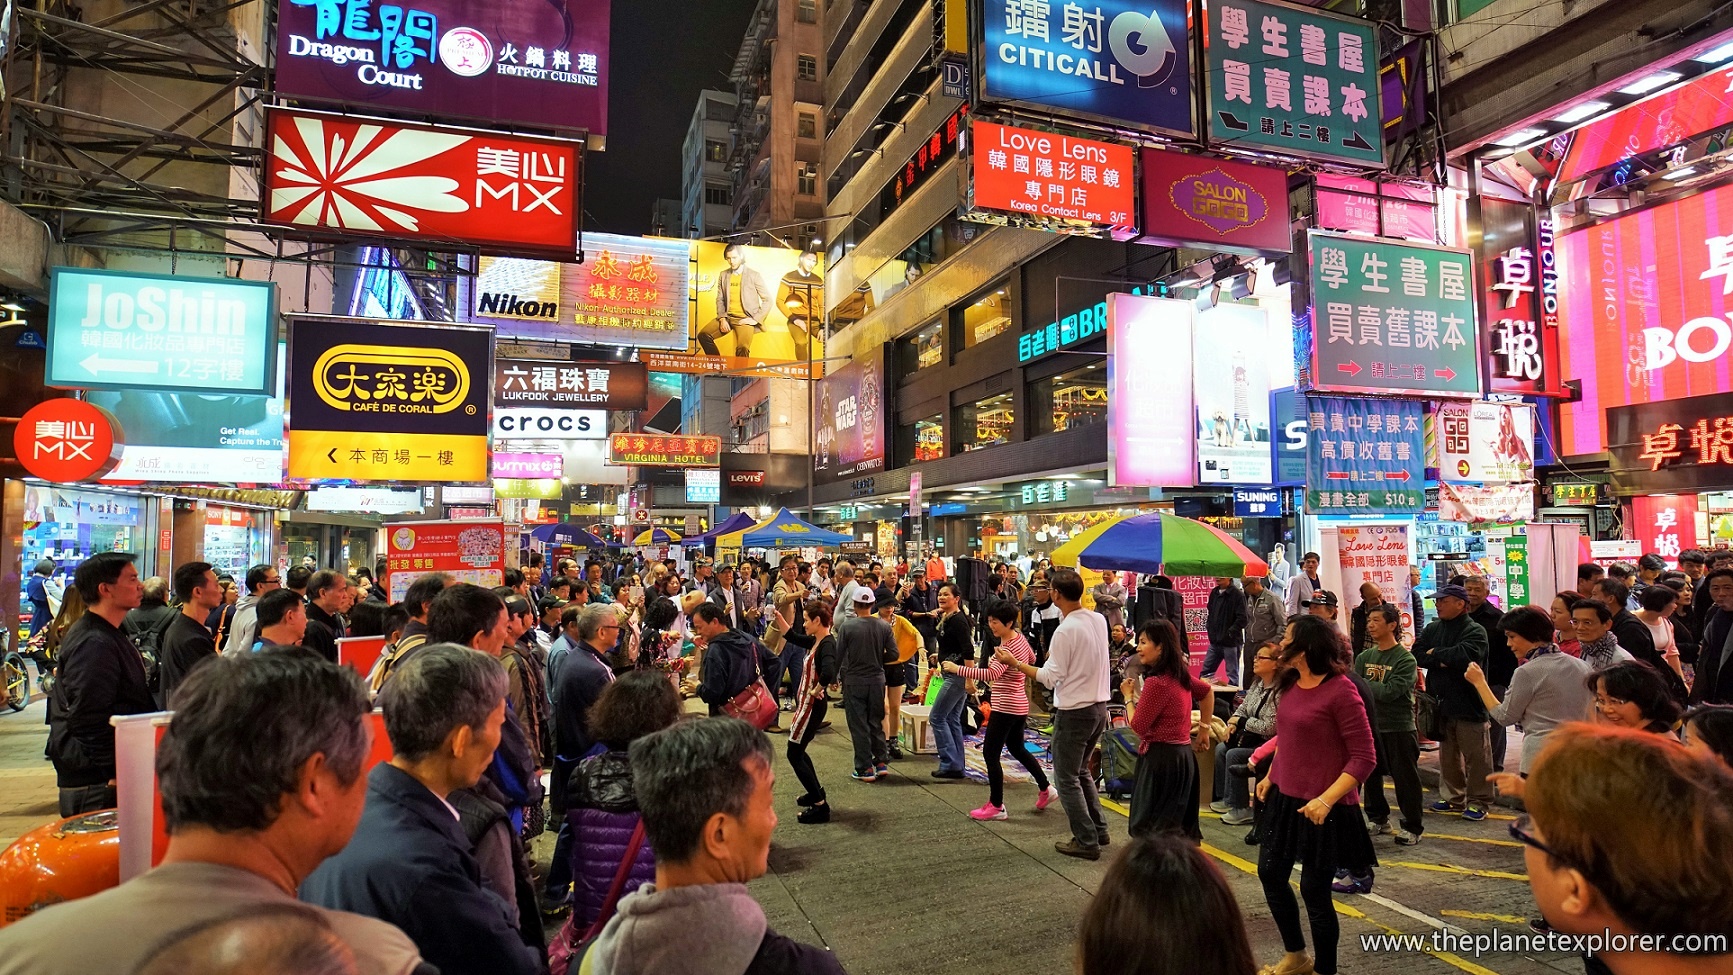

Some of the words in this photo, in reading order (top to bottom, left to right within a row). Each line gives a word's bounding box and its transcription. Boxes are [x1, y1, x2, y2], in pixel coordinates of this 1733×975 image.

[288, 34, 375, 64] Dragon
[1220, 5, 1366, 74] 學生書屋
[498, 42, 598, 74] 火鍋料理
[998, 43, 1125, 86] CITICALL
[357, 65, 423, 90] Court
[497, 63, 548, 80] HOTPOT
[550, 70, 598, 87] CUISINE
[1222, 60, 1368, 123] 買賣課本
[1260, 117, 1331, 143] 請上二樓
[999, 127, 1051, 156] Love
[1062, 137, 1108, 164] Lens
[477, 146, 565, 183] 美心
[987, 148, 1121, 189] 韓國隱形眼鏡
[475, 178, 564, 215] MX
[1024, 180, 1088, 208] 專門店
[1193, 180, 1247, 203] SALON
[1343, 183, 1409, 211] Emket
[1010, 199, 1038, 213] Korea
[1041, 202, 1079, 219] Contact
[1081, 208, 1102, 221] Lens
[1109, 211, 1128, 224] 3/F
[1345, 207, 1409, 225] 韓國化超市
[1320, 246, 1467, 301] 學生書屋
[1540, 218, 1559, 329] BONJOUR
[81, 283, 247, 336] JoShin
[478, 292, 558, 318] Nikon
[575, 302, 600, 313] Nikon
[602, 304, 647, 316] Authorized
[650, 307, 676, 318] Dealer
[1327, 302, 1467, 351] 買賣舊課本
[1642, 310, 1733, 372] BO
[503, 365, 611, 394] 六福珠寶
[1370, 361, 1427, 381] 請上二樓
[352, 401, 380, 412] CAFÉ
[382, 403, 397, 412] DE
[398, 404, 433, 414] CORAL
[502, 391, 549, 401] LUKFOOK
[552, 392, 610, 403] JEWELLERY
[836, 395, 857, 417] STAR
[499, 415, 591, 431] crocs
[836, 410, 857, 432] WARS
[1309, 412, 1419, 434] 買賣中學課本
[1443, 409, 1469, 417] SALON
[35, 419, 95, 440] 美心
[219, 427, 237, 436] Get
[238, 427, 260, 437] Real.
[33, 440, 93, 461] MX
[219, 436, 255, 446] Capture
[256, 437, 270, 446] the
[614, 436, 718, 454] 維珍尼亞賓館
[1321, 439, 1411, 461] 高價收舊書
[1638, 416, 1733, 472] 卓悅
[349, 447, 455, 467] 本商場一樓
[623, 453, 668, 463] VIRGINIA
[674, 455, 708, 464] HOTEL
[1236, 492, 1278, 502] SUNING
[1319, 491, 1370, 508] 漫畫全部
[1385, 493, 1405, 506] $10
[207, 510, 223, 519] SONY
[1345, 535, 1374, 552] Love
[1376, 535, 1405, 551] Lens
[390, 559, 410, 570] 批發
[1361, 570, 1394, 583] 專門店
[1181, 591, 1209, 606] 超市
